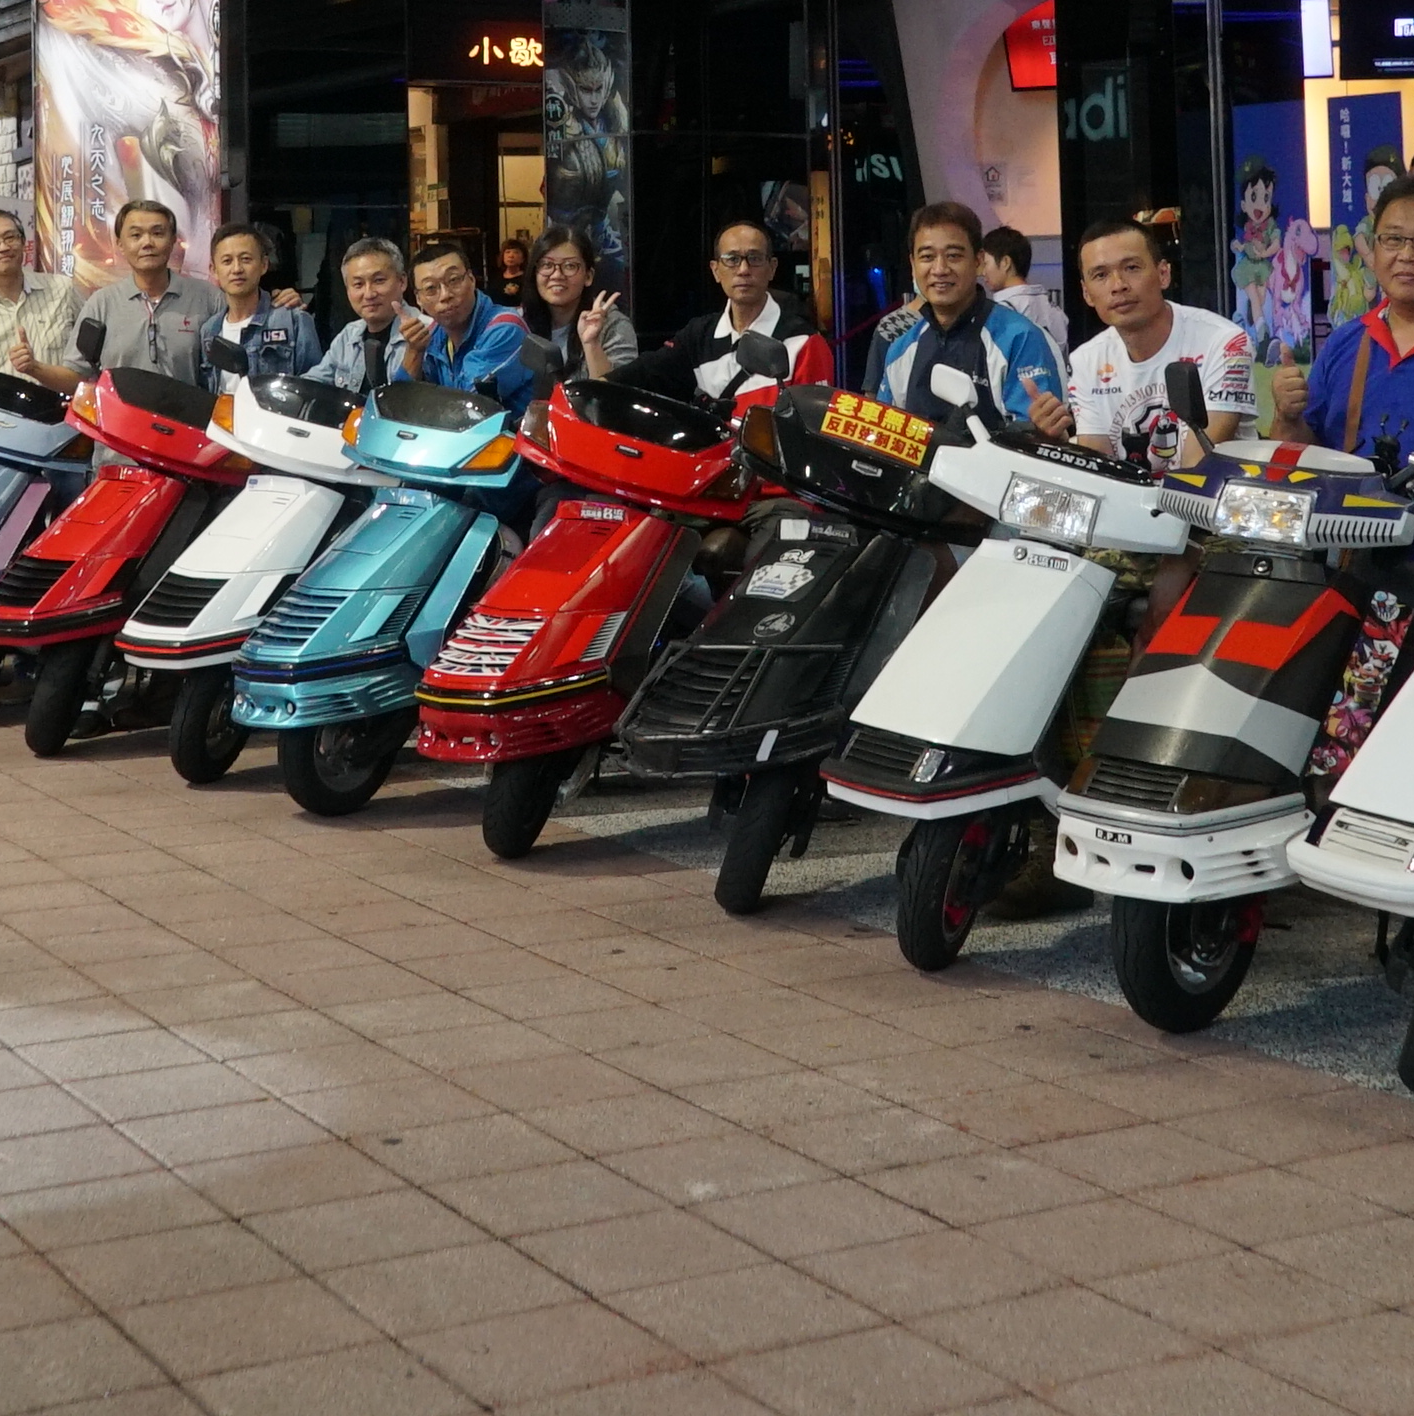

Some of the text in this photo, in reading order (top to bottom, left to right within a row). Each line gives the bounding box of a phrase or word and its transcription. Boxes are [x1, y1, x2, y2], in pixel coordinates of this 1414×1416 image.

[469, 36, 543, 68] 小歇
[263, 330, 287, 343] USA
[834, 391, 935, 445] 老車無罪
[1036, 445, 1100, 473] HONDA
[1049, 557, 1069, 571] 100
